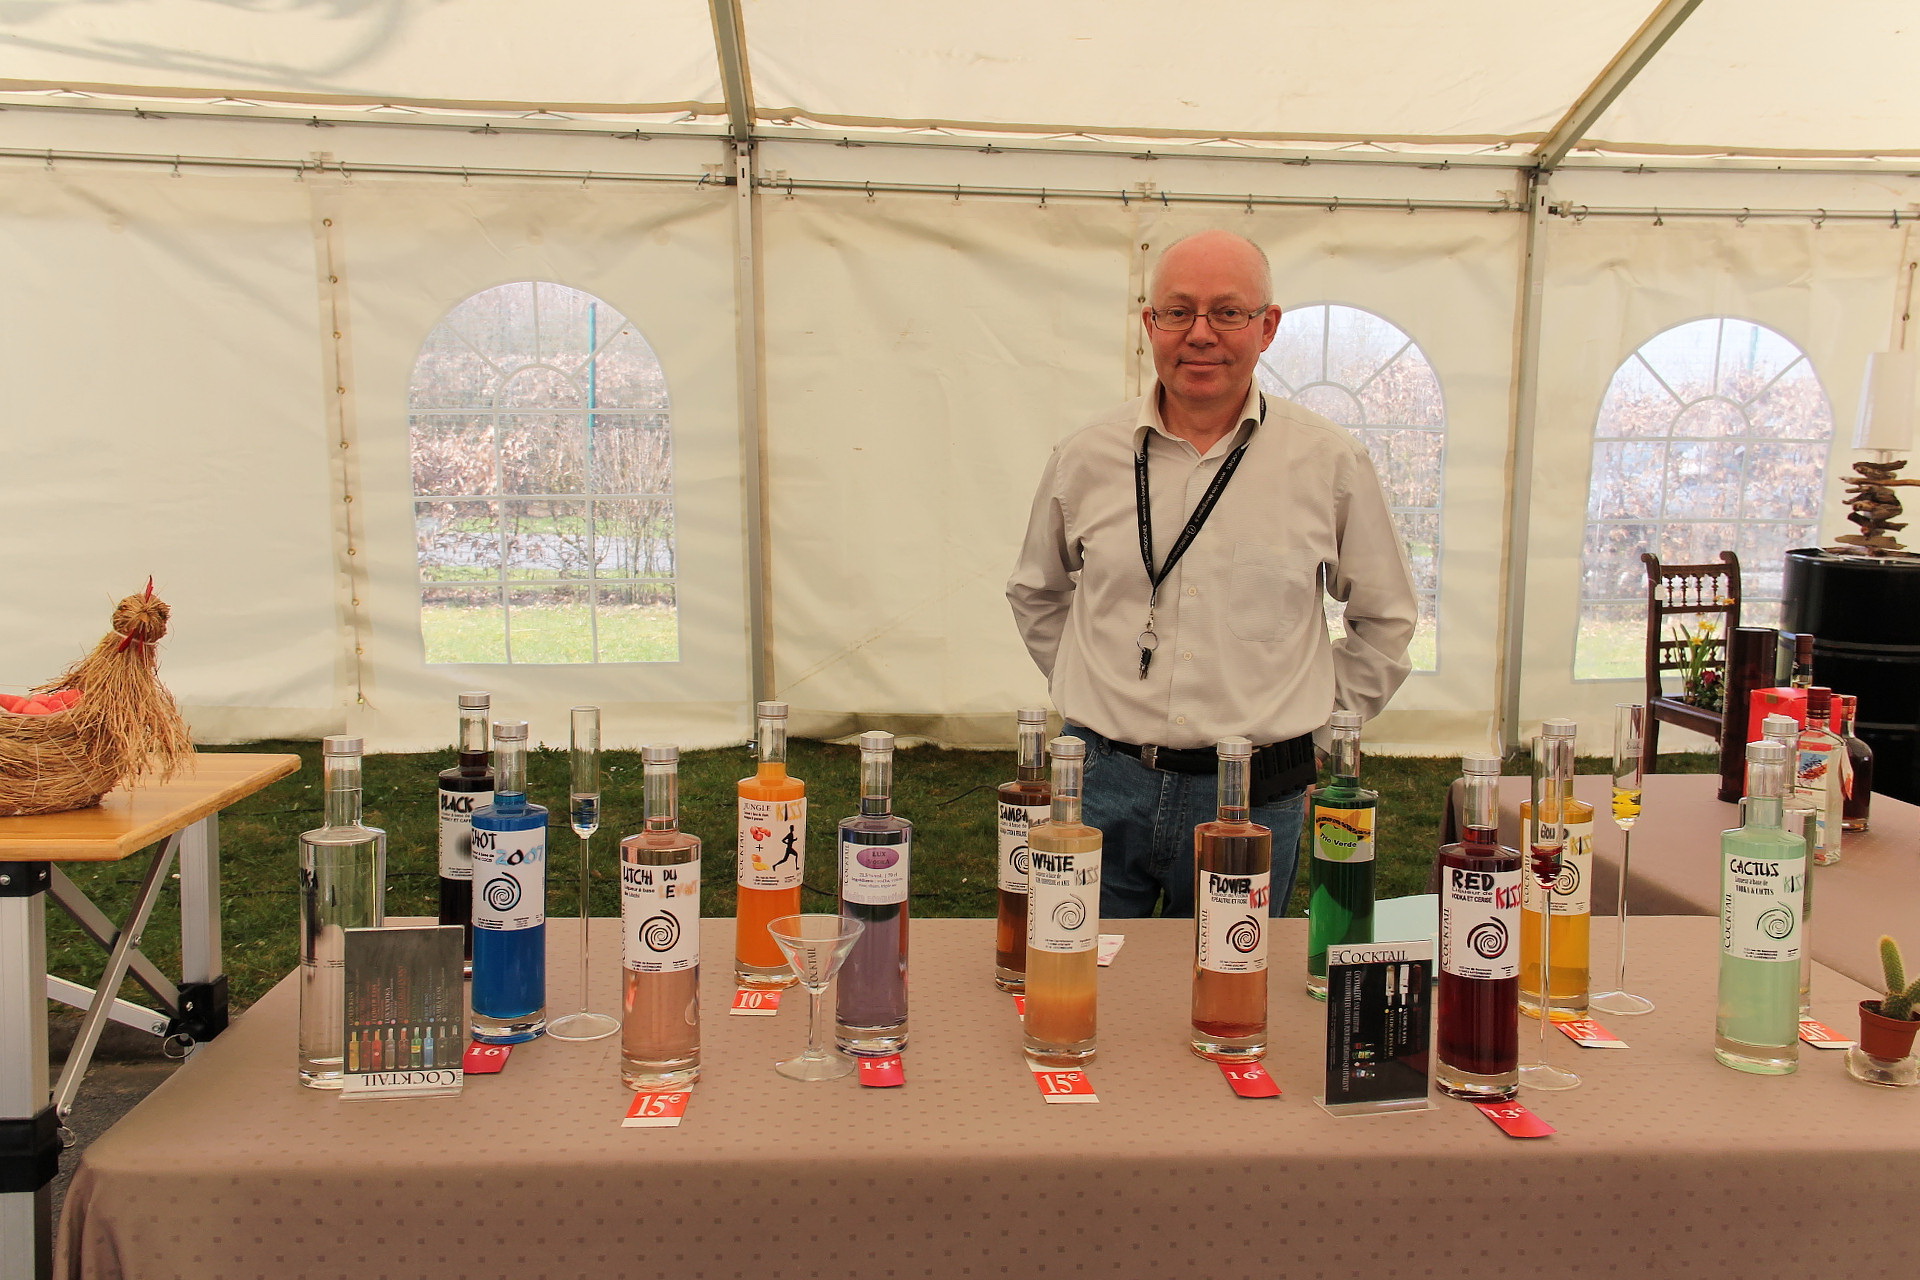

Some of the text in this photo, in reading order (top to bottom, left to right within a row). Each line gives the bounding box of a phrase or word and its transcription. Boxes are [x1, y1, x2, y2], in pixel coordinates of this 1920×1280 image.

[743, 802, 772, 812] JUNGLE
[1000, 804, 1029, 823] SAMBA
[471, 828, 497, 850] SHOT
[1032, 852, 1075, 873] WHITE
[1730, 858, 1780, 877] CACTUS
[663, 868, 678, 882] DU
[1452, 869, 1495, 891] RED
[1209, 873, 1271, 908] FLOWER KIS
[1724, 894, 1732, 949] COCKTAIL
[1200, 909, 1208, 962] COCKTAIL
[1442, 908, 1450, 966] COCKTAIL
[1339, 949, 1409, 964] COCKTAIL
[737, 992, 776, 1009] 10€
[361, 1070, 456, 1086] COCKTAIL
[1041, 1073, 1081, 1094] 15€
[633, 1093, 682, 1117] 15€
